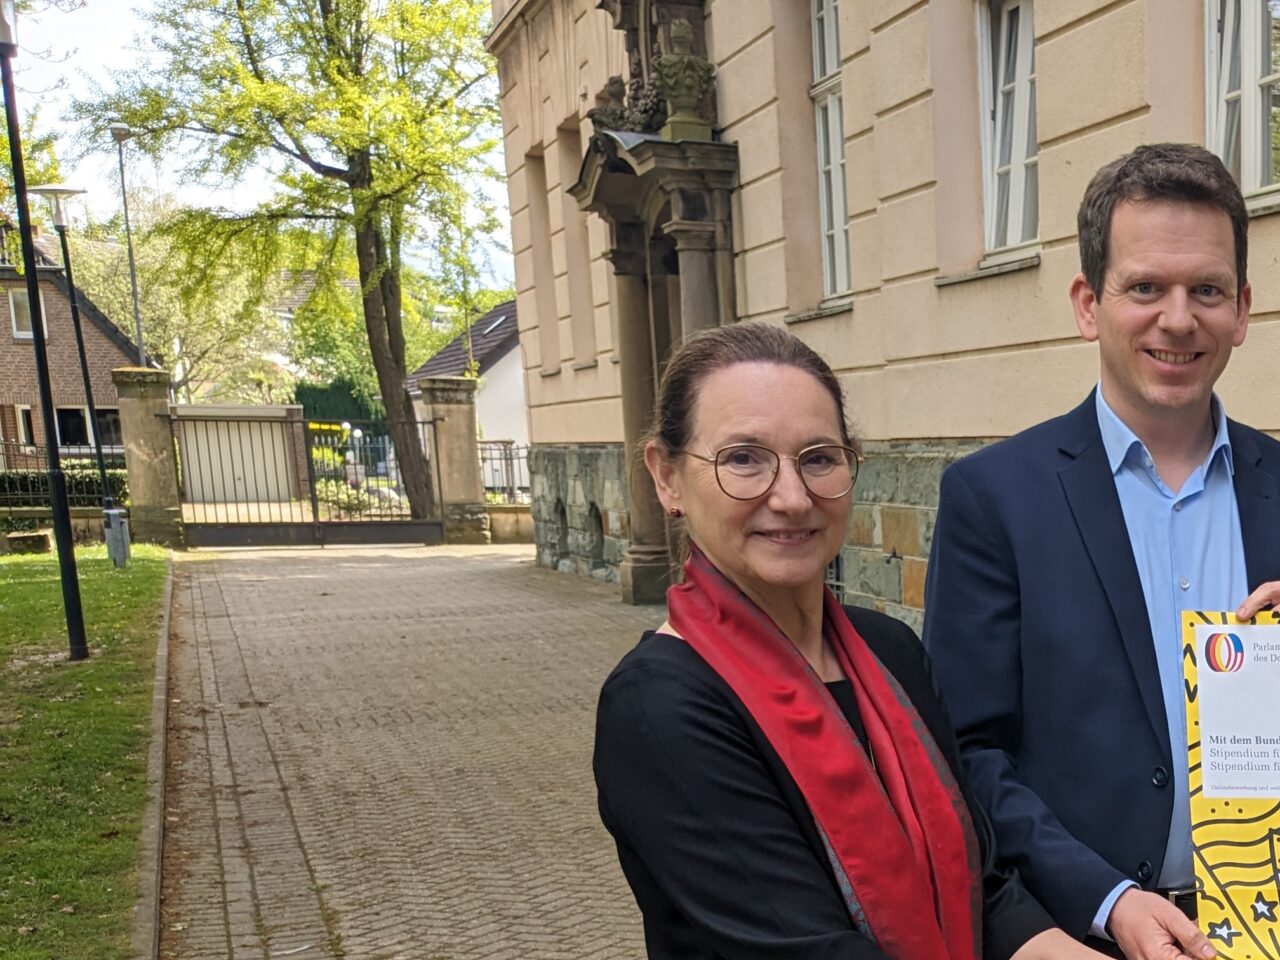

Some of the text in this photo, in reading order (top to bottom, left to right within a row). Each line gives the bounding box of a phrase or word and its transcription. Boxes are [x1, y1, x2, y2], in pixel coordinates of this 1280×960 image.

[1253, 653, 1268, 662] des
[1209, 735, 1227, 745] Mit
[1229, 735, 1252, 745] dem
[1209, 748, 1269, 759] Stipendium
[1210, 761, 1270, 773] Stipendium
